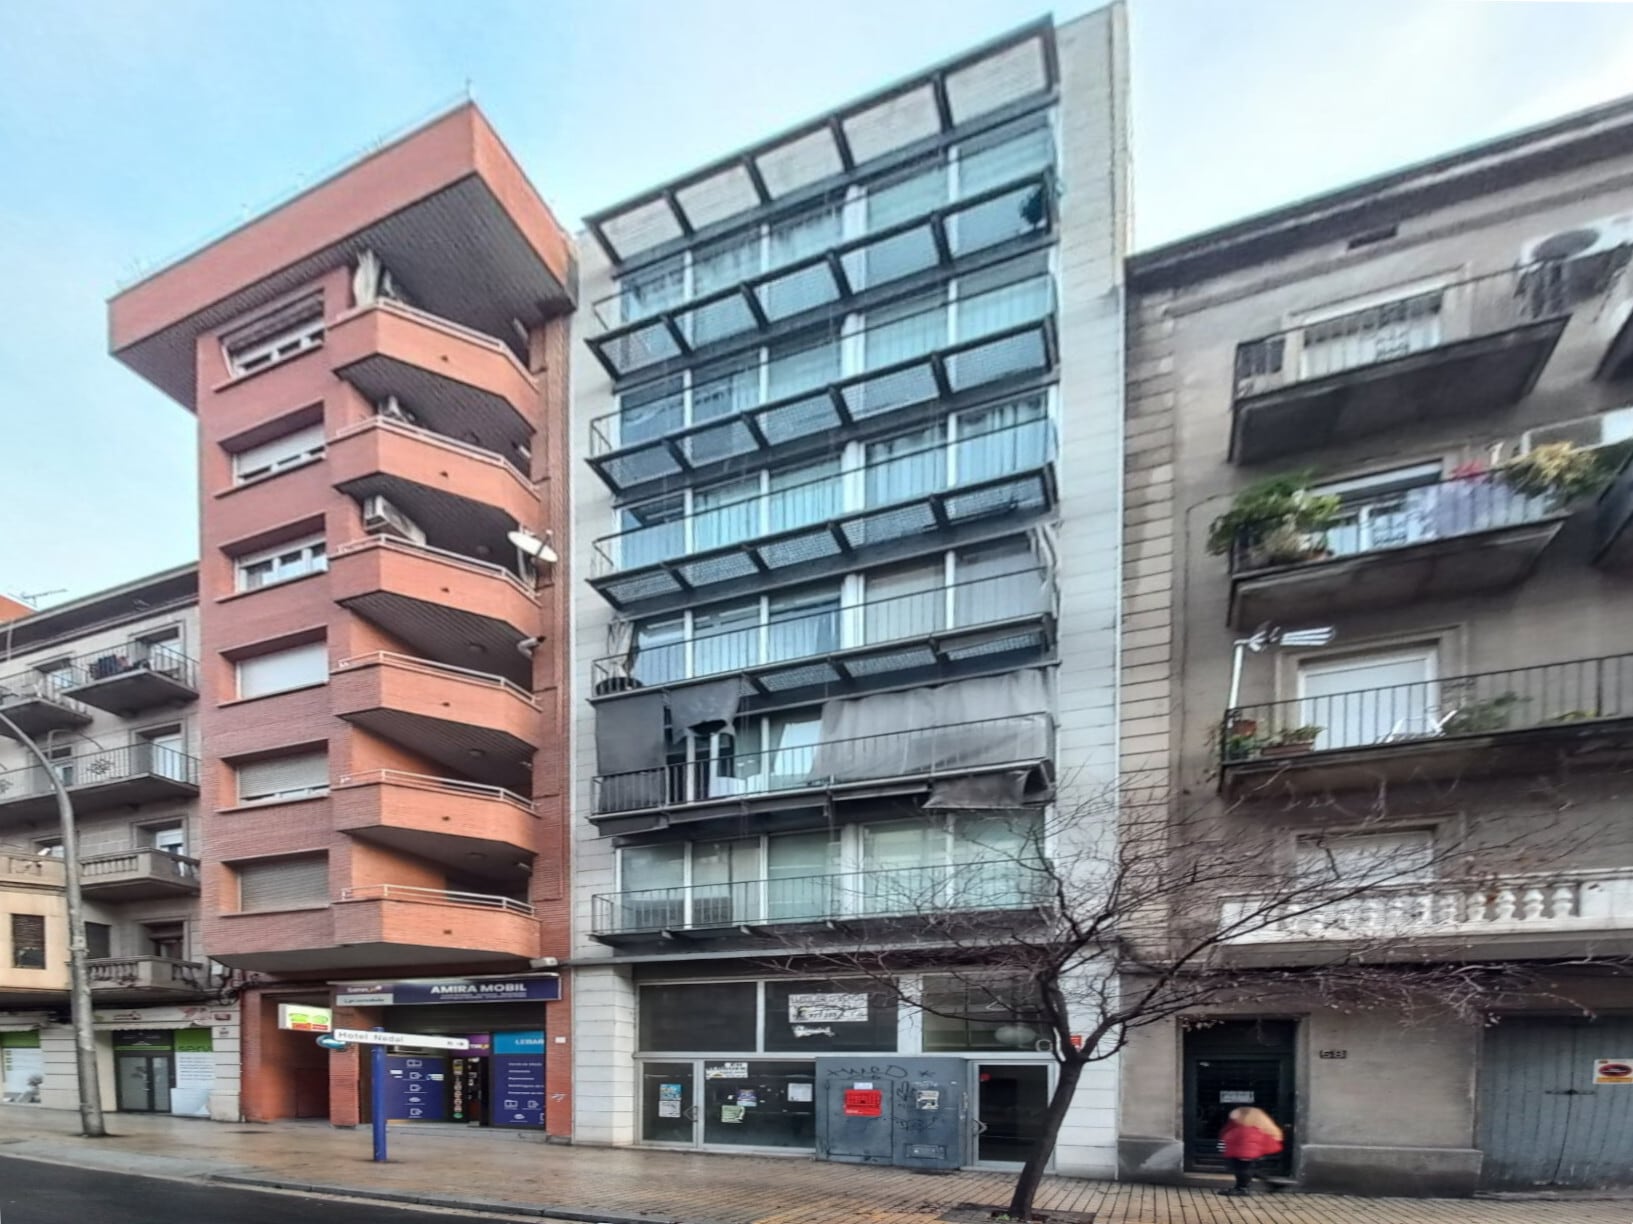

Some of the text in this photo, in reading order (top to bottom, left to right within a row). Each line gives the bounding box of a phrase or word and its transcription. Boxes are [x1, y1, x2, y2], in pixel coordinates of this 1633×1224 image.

[430, 983, 527, 994] AMIRA MOBIL
[338, 1031, 369, 1041] Hotel
